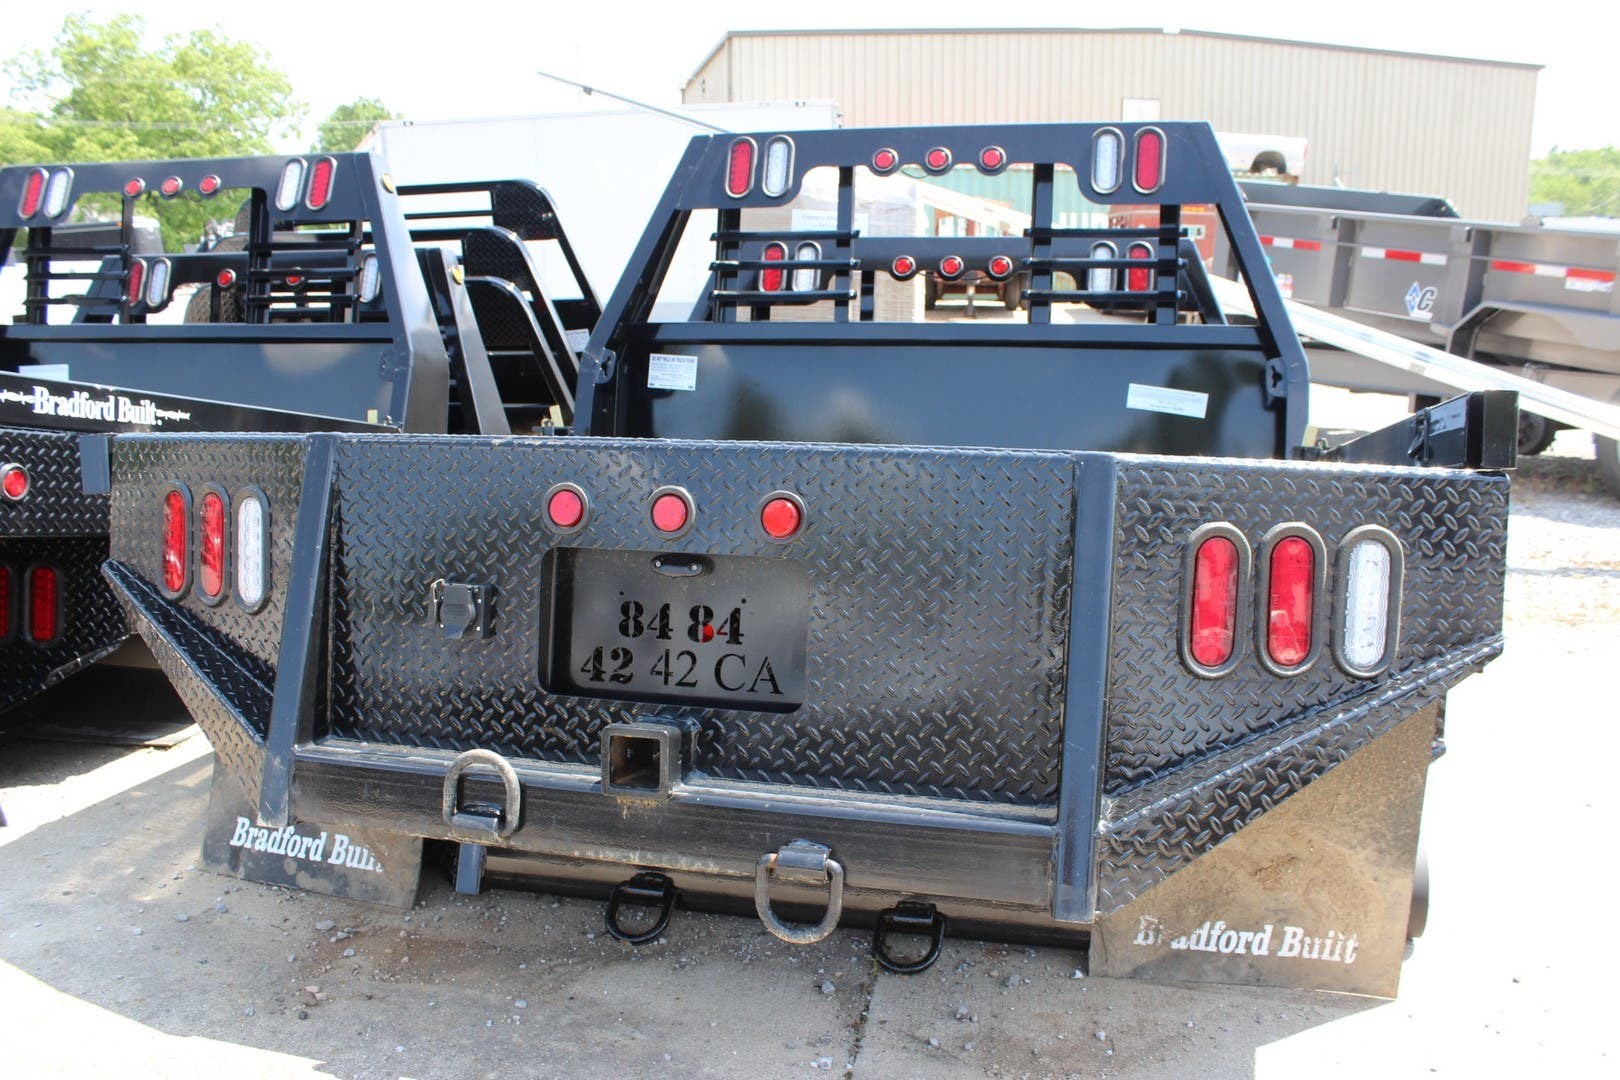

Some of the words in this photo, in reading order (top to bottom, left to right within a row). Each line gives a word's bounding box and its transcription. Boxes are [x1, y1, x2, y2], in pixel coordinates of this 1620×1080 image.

[32, 385, 116, 422] Bradford
[580, 646, 634, 684] 42
[649, 648, 698, 688] 42
[713, 652, 784, 695] CA
[229, 815, 329, 862] Bradford
[1276, 925, 1360, 964] Built
